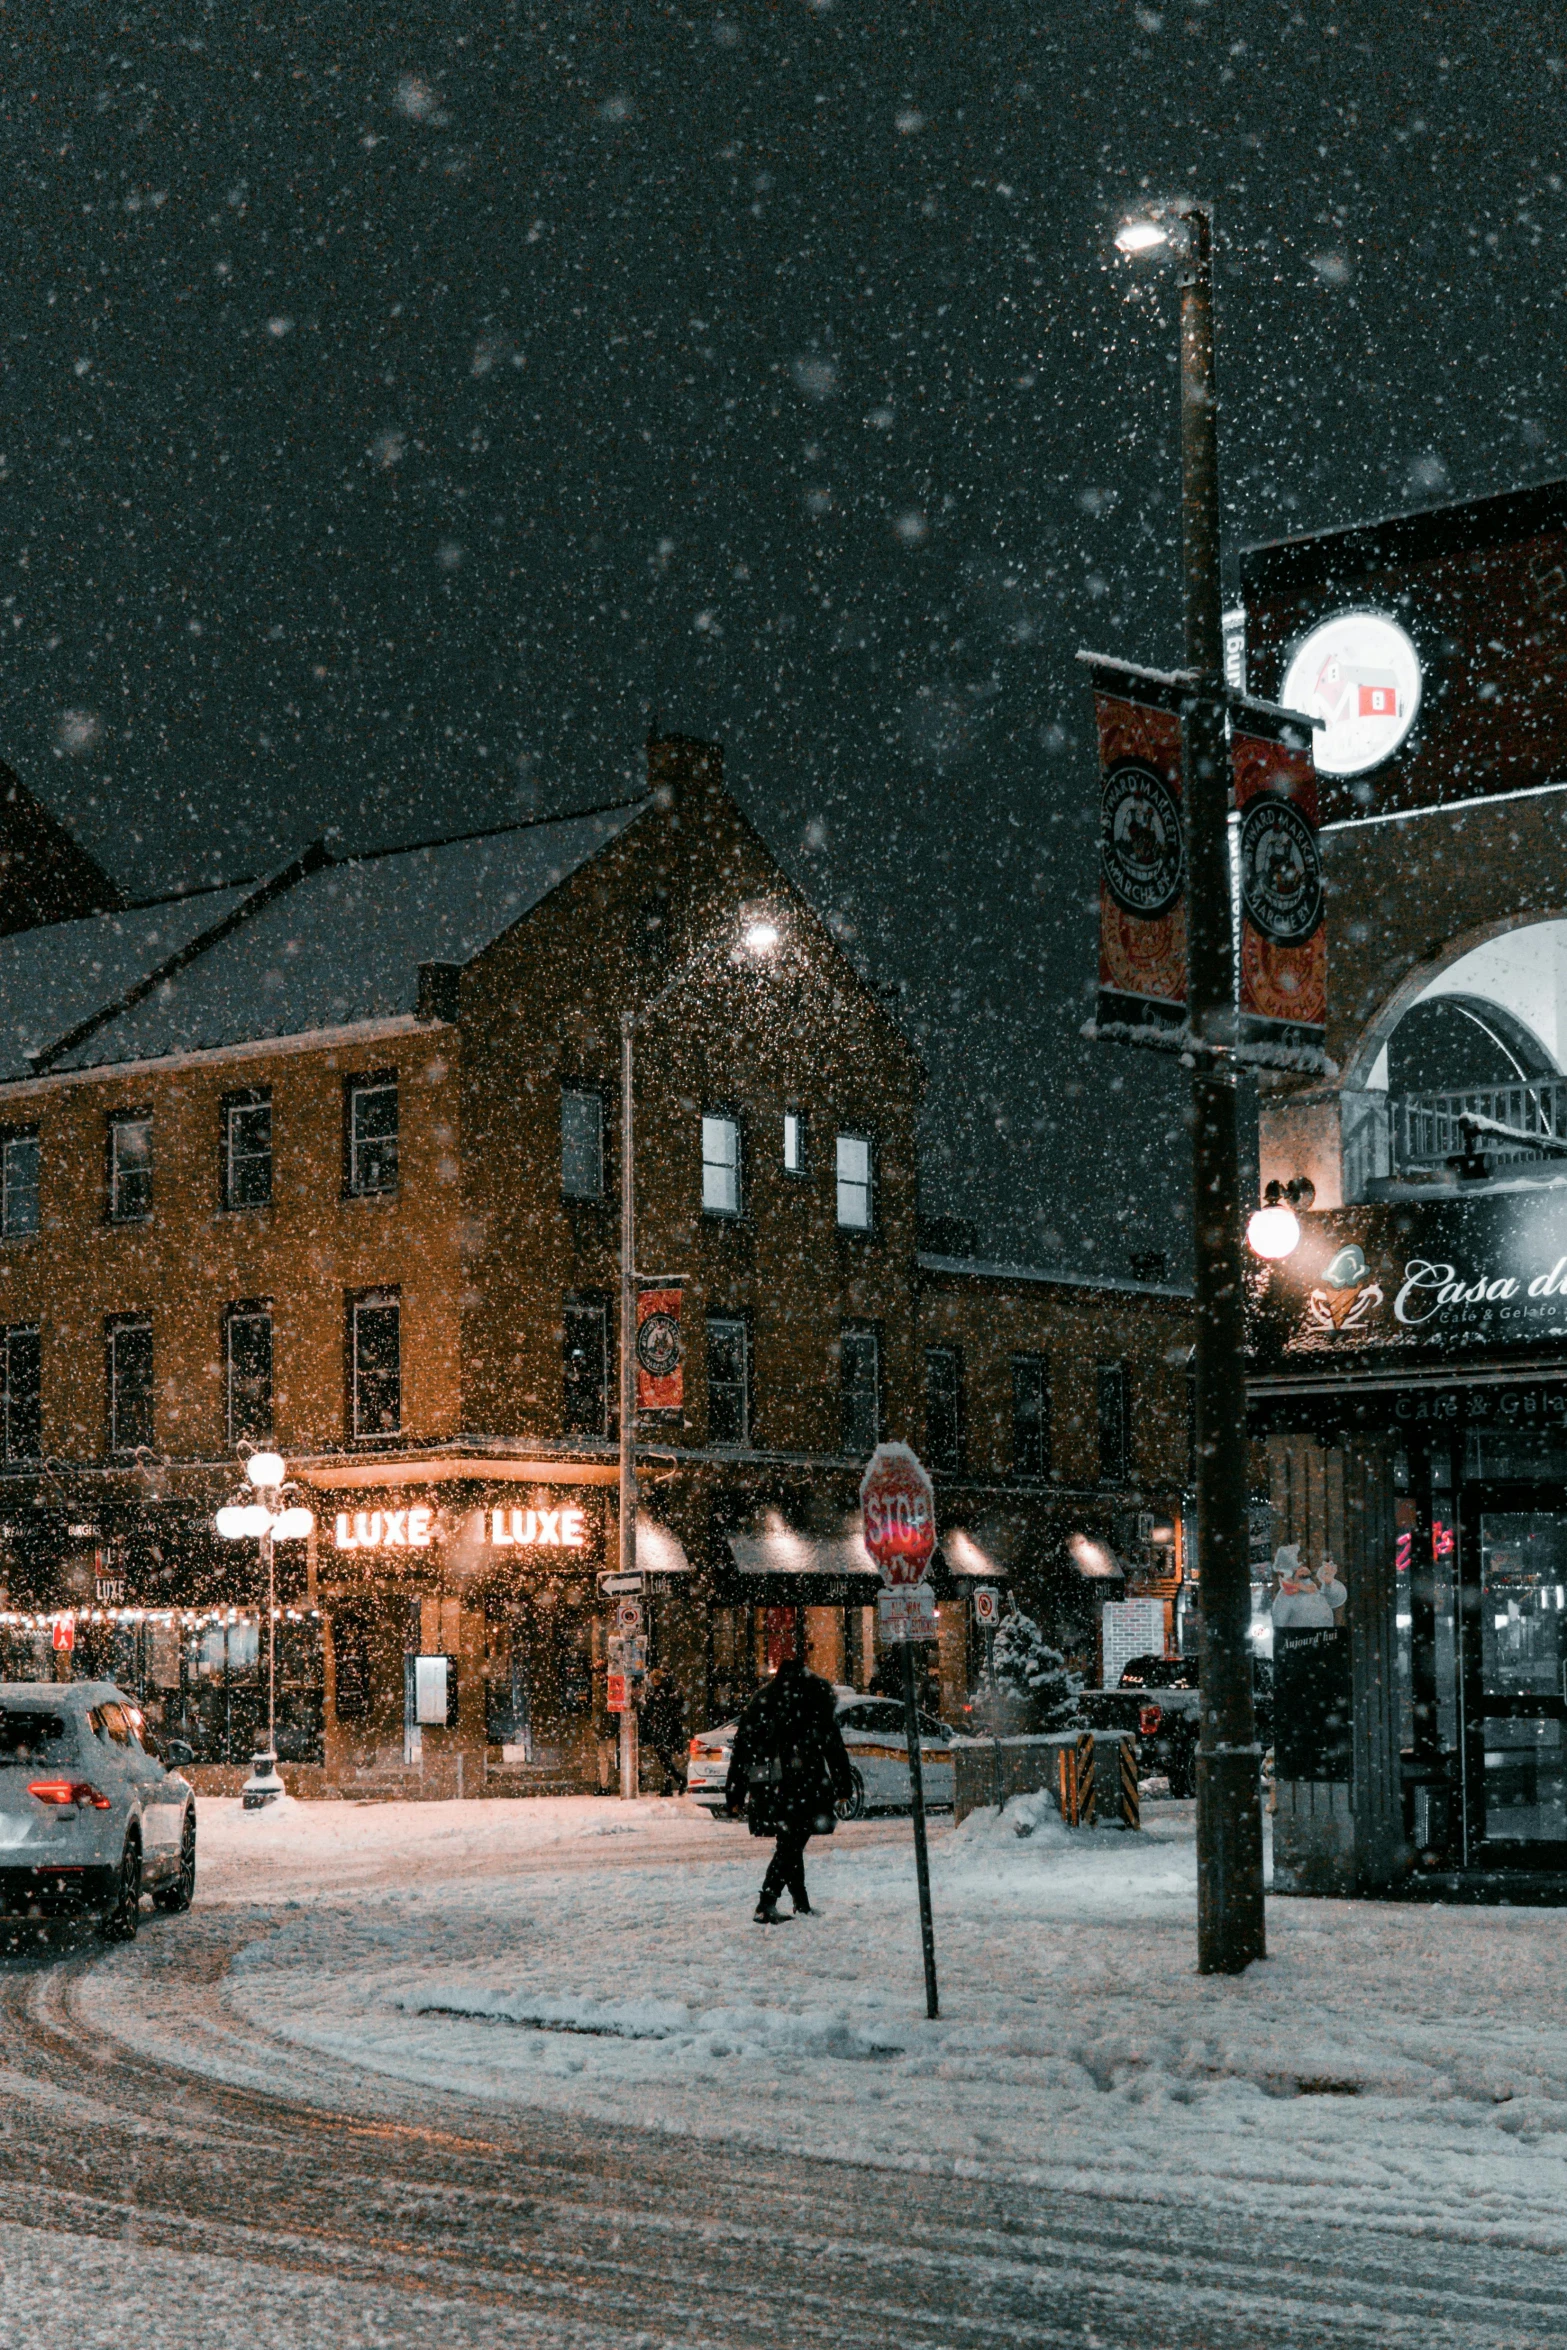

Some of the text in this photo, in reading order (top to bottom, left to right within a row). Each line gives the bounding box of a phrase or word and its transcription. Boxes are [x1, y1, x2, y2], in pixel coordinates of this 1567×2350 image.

[1139, 779, 1177, 844] MARKET
[1278, 811, 1317, 874] MARKET
[1297, 900, 1311, 922] BY
[1394, 1259, 1520, 1324] Casa
[1482, 1308, 1494, 1321] &
[1499, 1303, 1557, 1320] Gelato
[1472, 1393, 1489, 1416] &
[68, 1524, 102, 1536] BURGERS
[336, 1509, 431, 1549] LUXE
[492, 1509, 584, 1547] LUXE
[868, 1494, 927, 1545] STOP
[96, 1580, 125, 1600] LUXE
